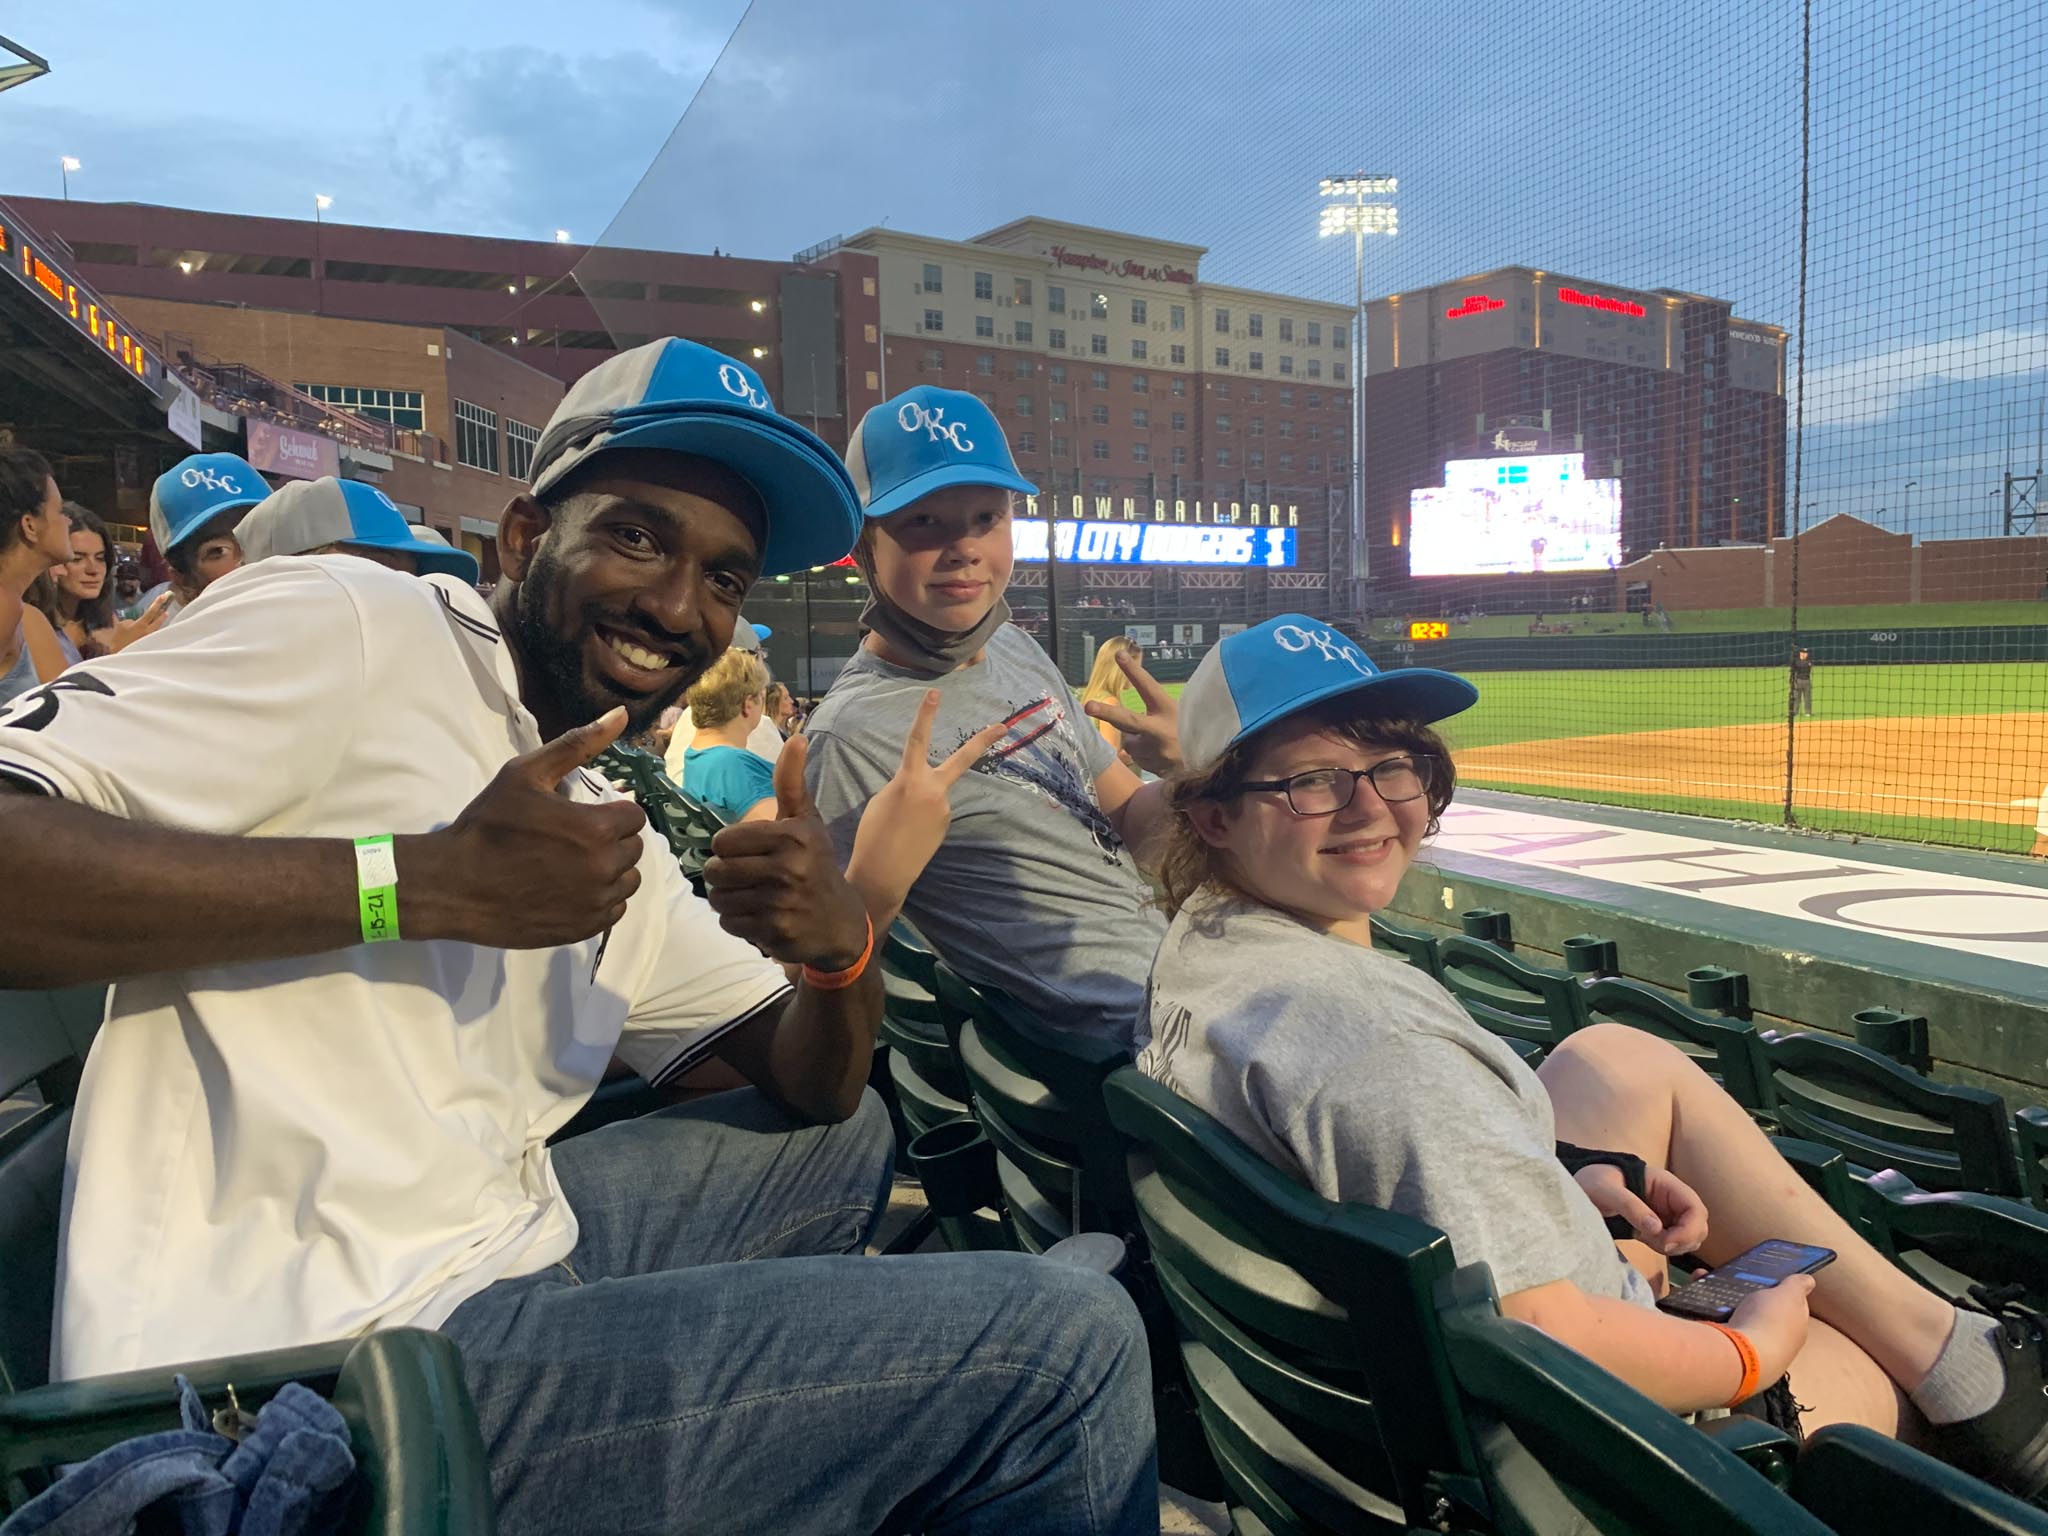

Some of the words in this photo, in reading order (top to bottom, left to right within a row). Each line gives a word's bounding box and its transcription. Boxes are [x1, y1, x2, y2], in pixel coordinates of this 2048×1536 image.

[1051, 246, 1109, 275] Hampton
[899, 402, 974, 452] OKC
[181, 468, 242, 495] OKC
[1155, 499, 1298, 526] BALLPARK
[1273, 625, 1373, 677] OKC
[1870, 632, 1897, 642] 400
